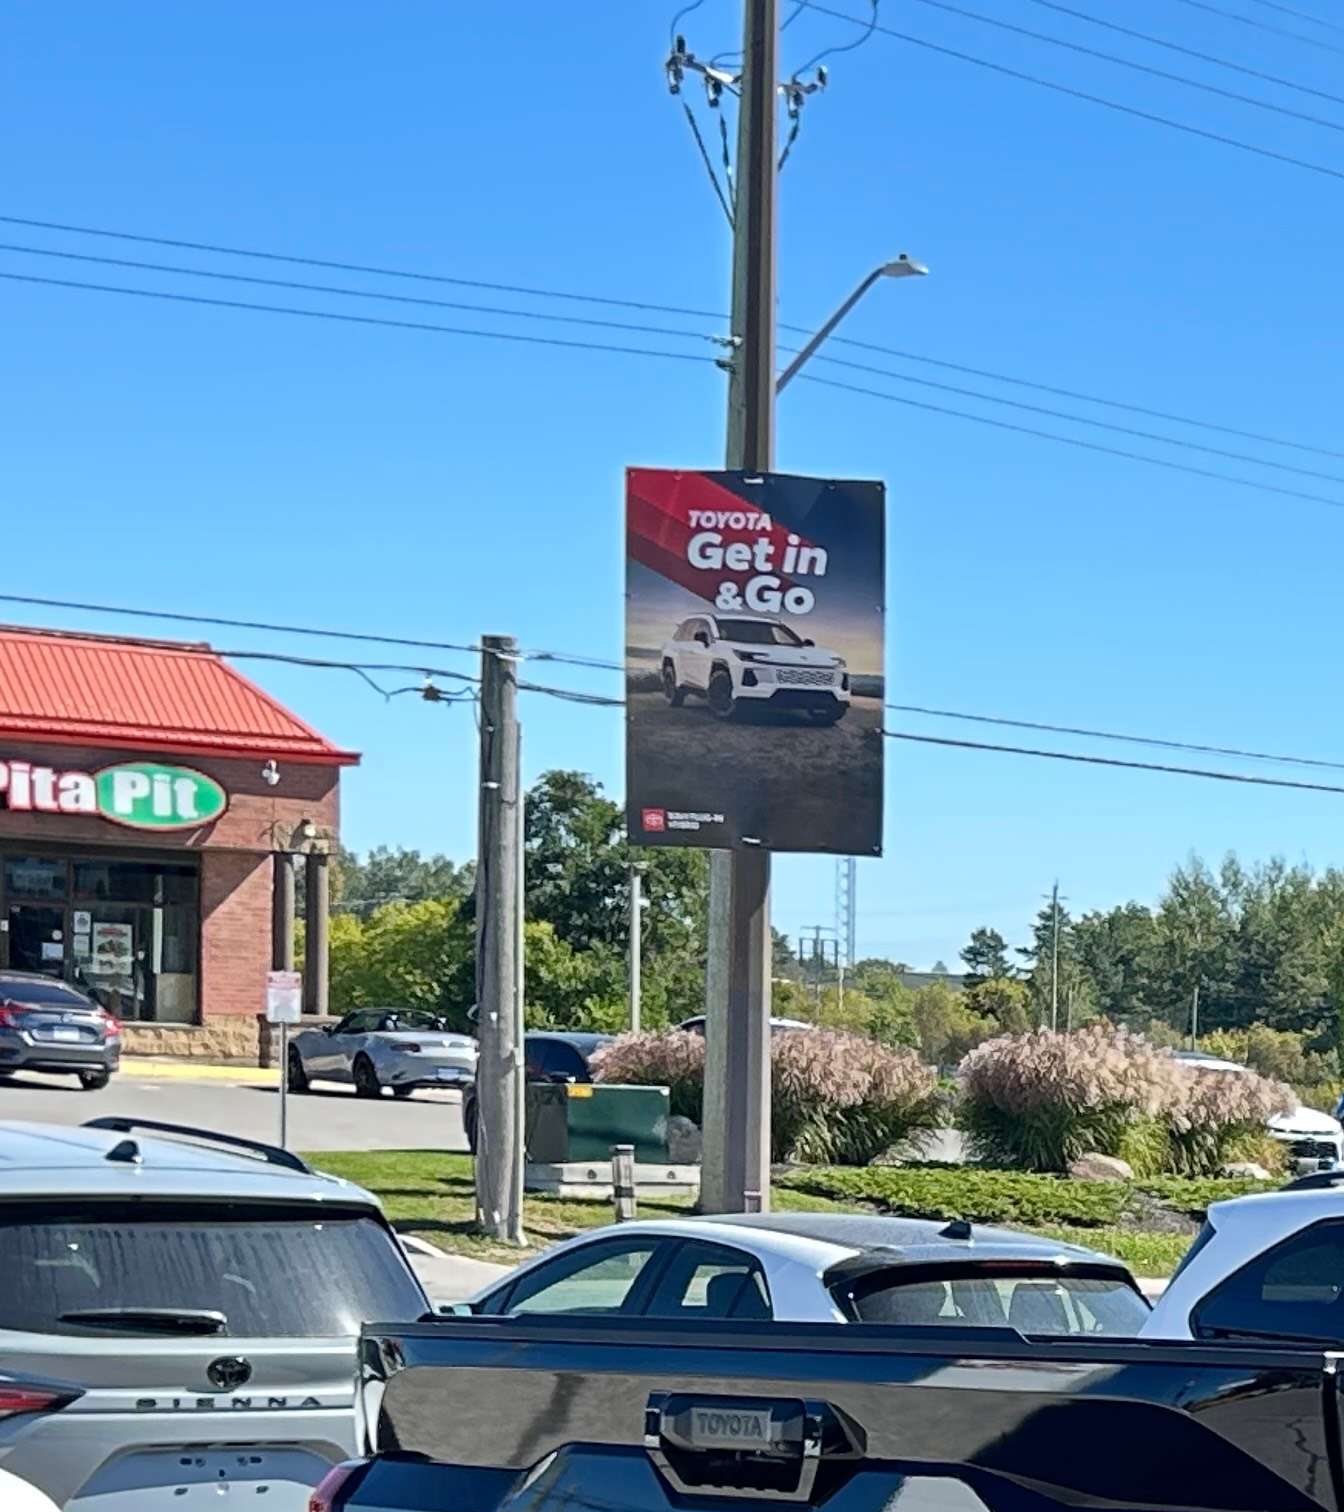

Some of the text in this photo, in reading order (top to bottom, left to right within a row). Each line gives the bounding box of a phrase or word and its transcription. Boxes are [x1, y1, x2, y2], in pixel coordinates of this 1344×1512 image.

[687, 509, 773, 531] TOYOTA
[687, 531, 829, 577] Get in
[715, 574, 816, 615] &Go
[112, 770, 200, 820] Pit
[696, 1411, 763, 1438] TOYOTA
